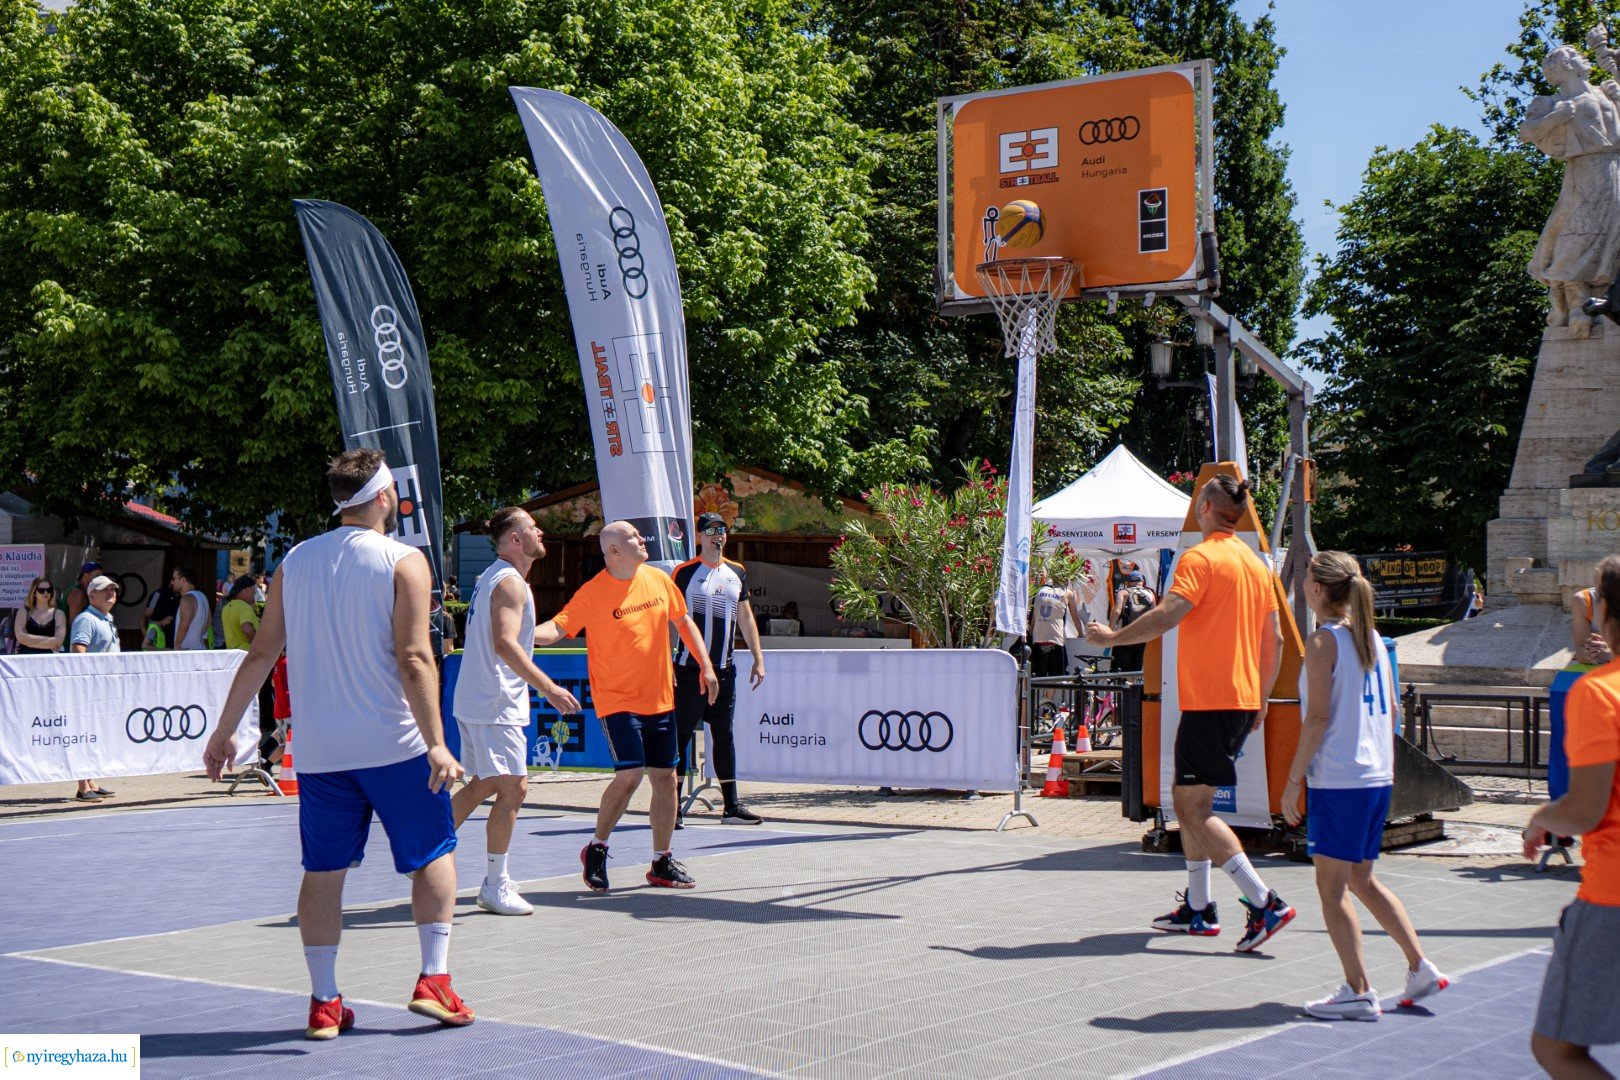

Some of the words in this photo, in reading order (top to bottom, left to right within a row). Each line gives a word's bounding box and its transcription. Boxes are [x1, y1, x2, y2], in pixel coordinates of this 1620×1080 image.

[1081, 155, 1106, 167] Audi
[1081, 166, 1128, 179] Hungaria
[6, 551, 42, 561] Klaudia
[1404, 561, 1415, 574] OF
[1363, 660, 1387, 716] 41
[31, 715, 67, 728] Audi
[759, 713, 794, 725] Audi
[31, 732, 97, 748] Hungaria
[759, 732, 826, 748] Hungaria
